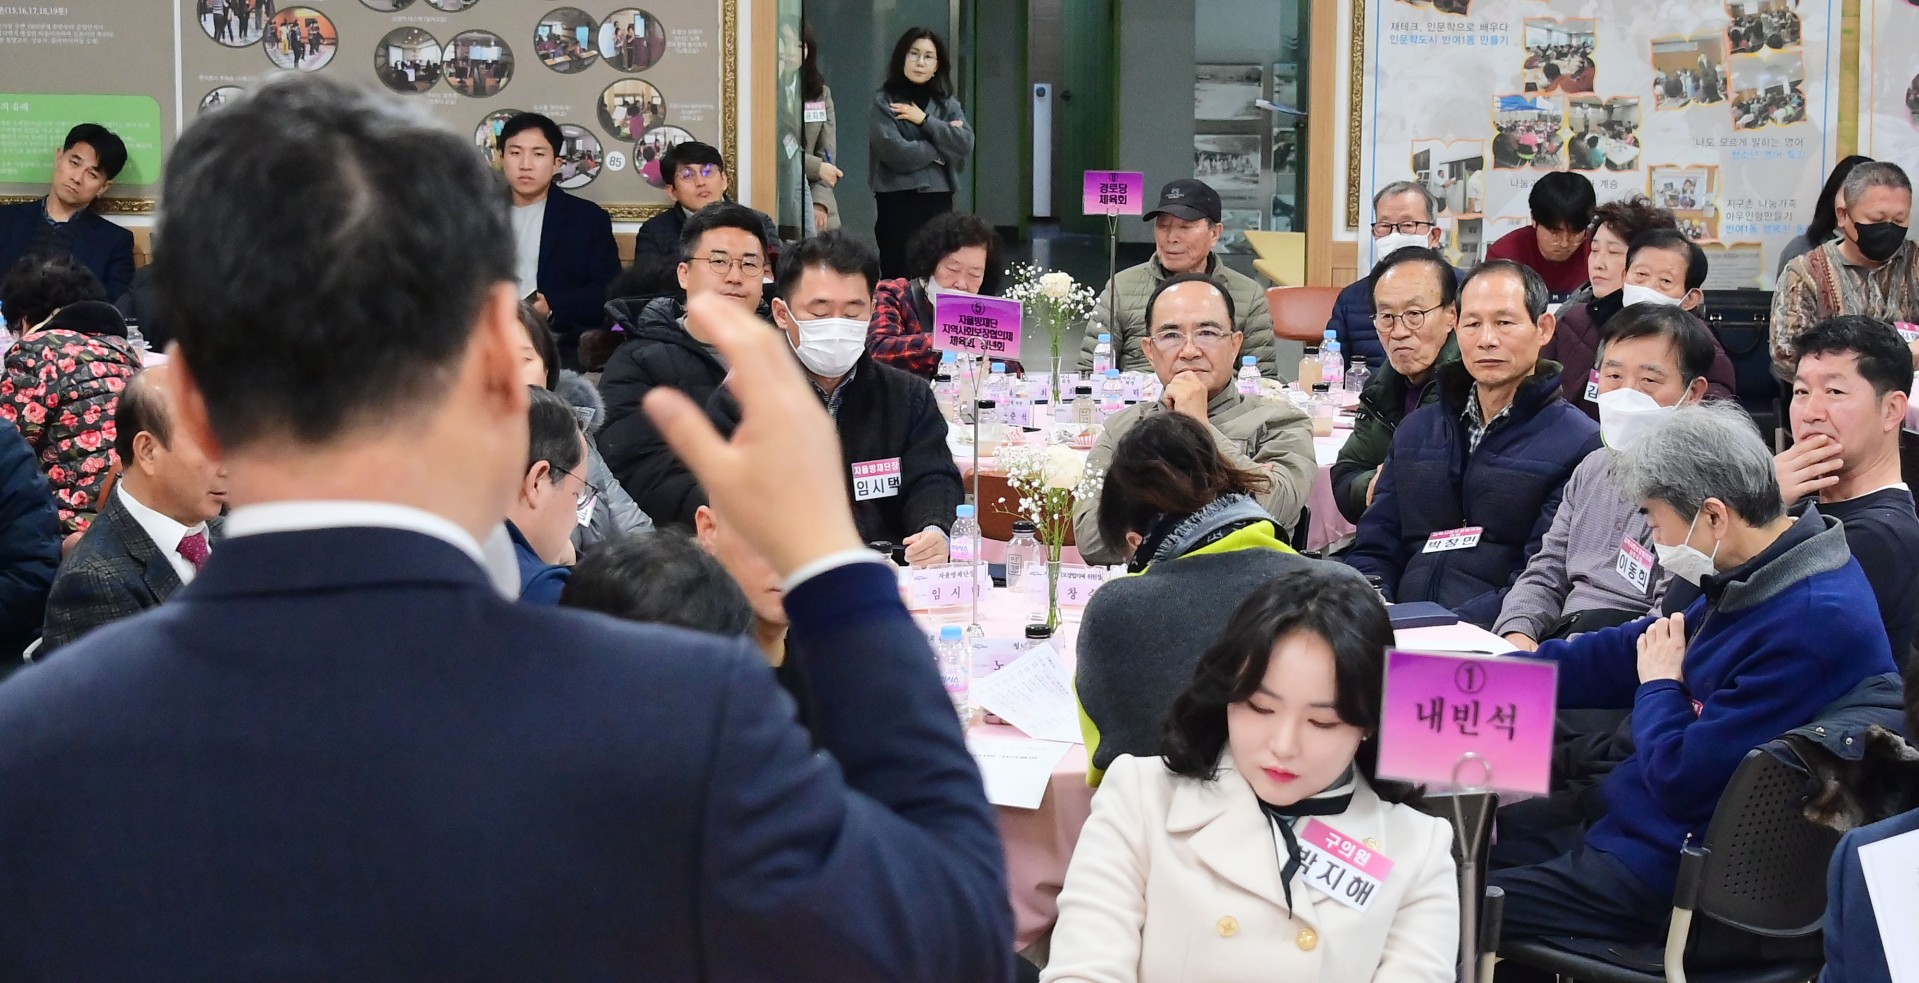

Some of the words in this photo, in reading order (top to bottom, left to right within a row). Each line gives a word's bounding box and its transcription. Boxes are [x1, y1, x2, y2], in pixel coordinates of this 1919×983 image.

[1391, 22, 1422, 33] 재테크,
[1426, 22, 1475, 33] 인문학으로
[1480, 22, 1509, 33] 배우다
[1389, 35, 1438, 45] 인문학도시
[1441, 35, 1475, 46] 반여1동
[1480, 35, 1509, 46] 만들기
[1695, 137, 1715, 147] 나도
[1719, 137, 1747, 148] 모르게
[1751, 137, 1780, 148] 말하는
[1784, 137, 1804, 148] 영어
[609, 156, 623, 168] 85
[1100, 182, 1128, 194] 경로당
[1099, 194, 1128, 206] 체육회
[854, 461, 899, 475] 자율방재단장
[856, 476, 900, 497] 임시택
[1618, 553, 1648, 589] 이동희
[1415, 695, 1518, 742] 내빈석
[1324, 831, 1372, 867] 구의원
[1298, 844, 1376, 907] 박지해
